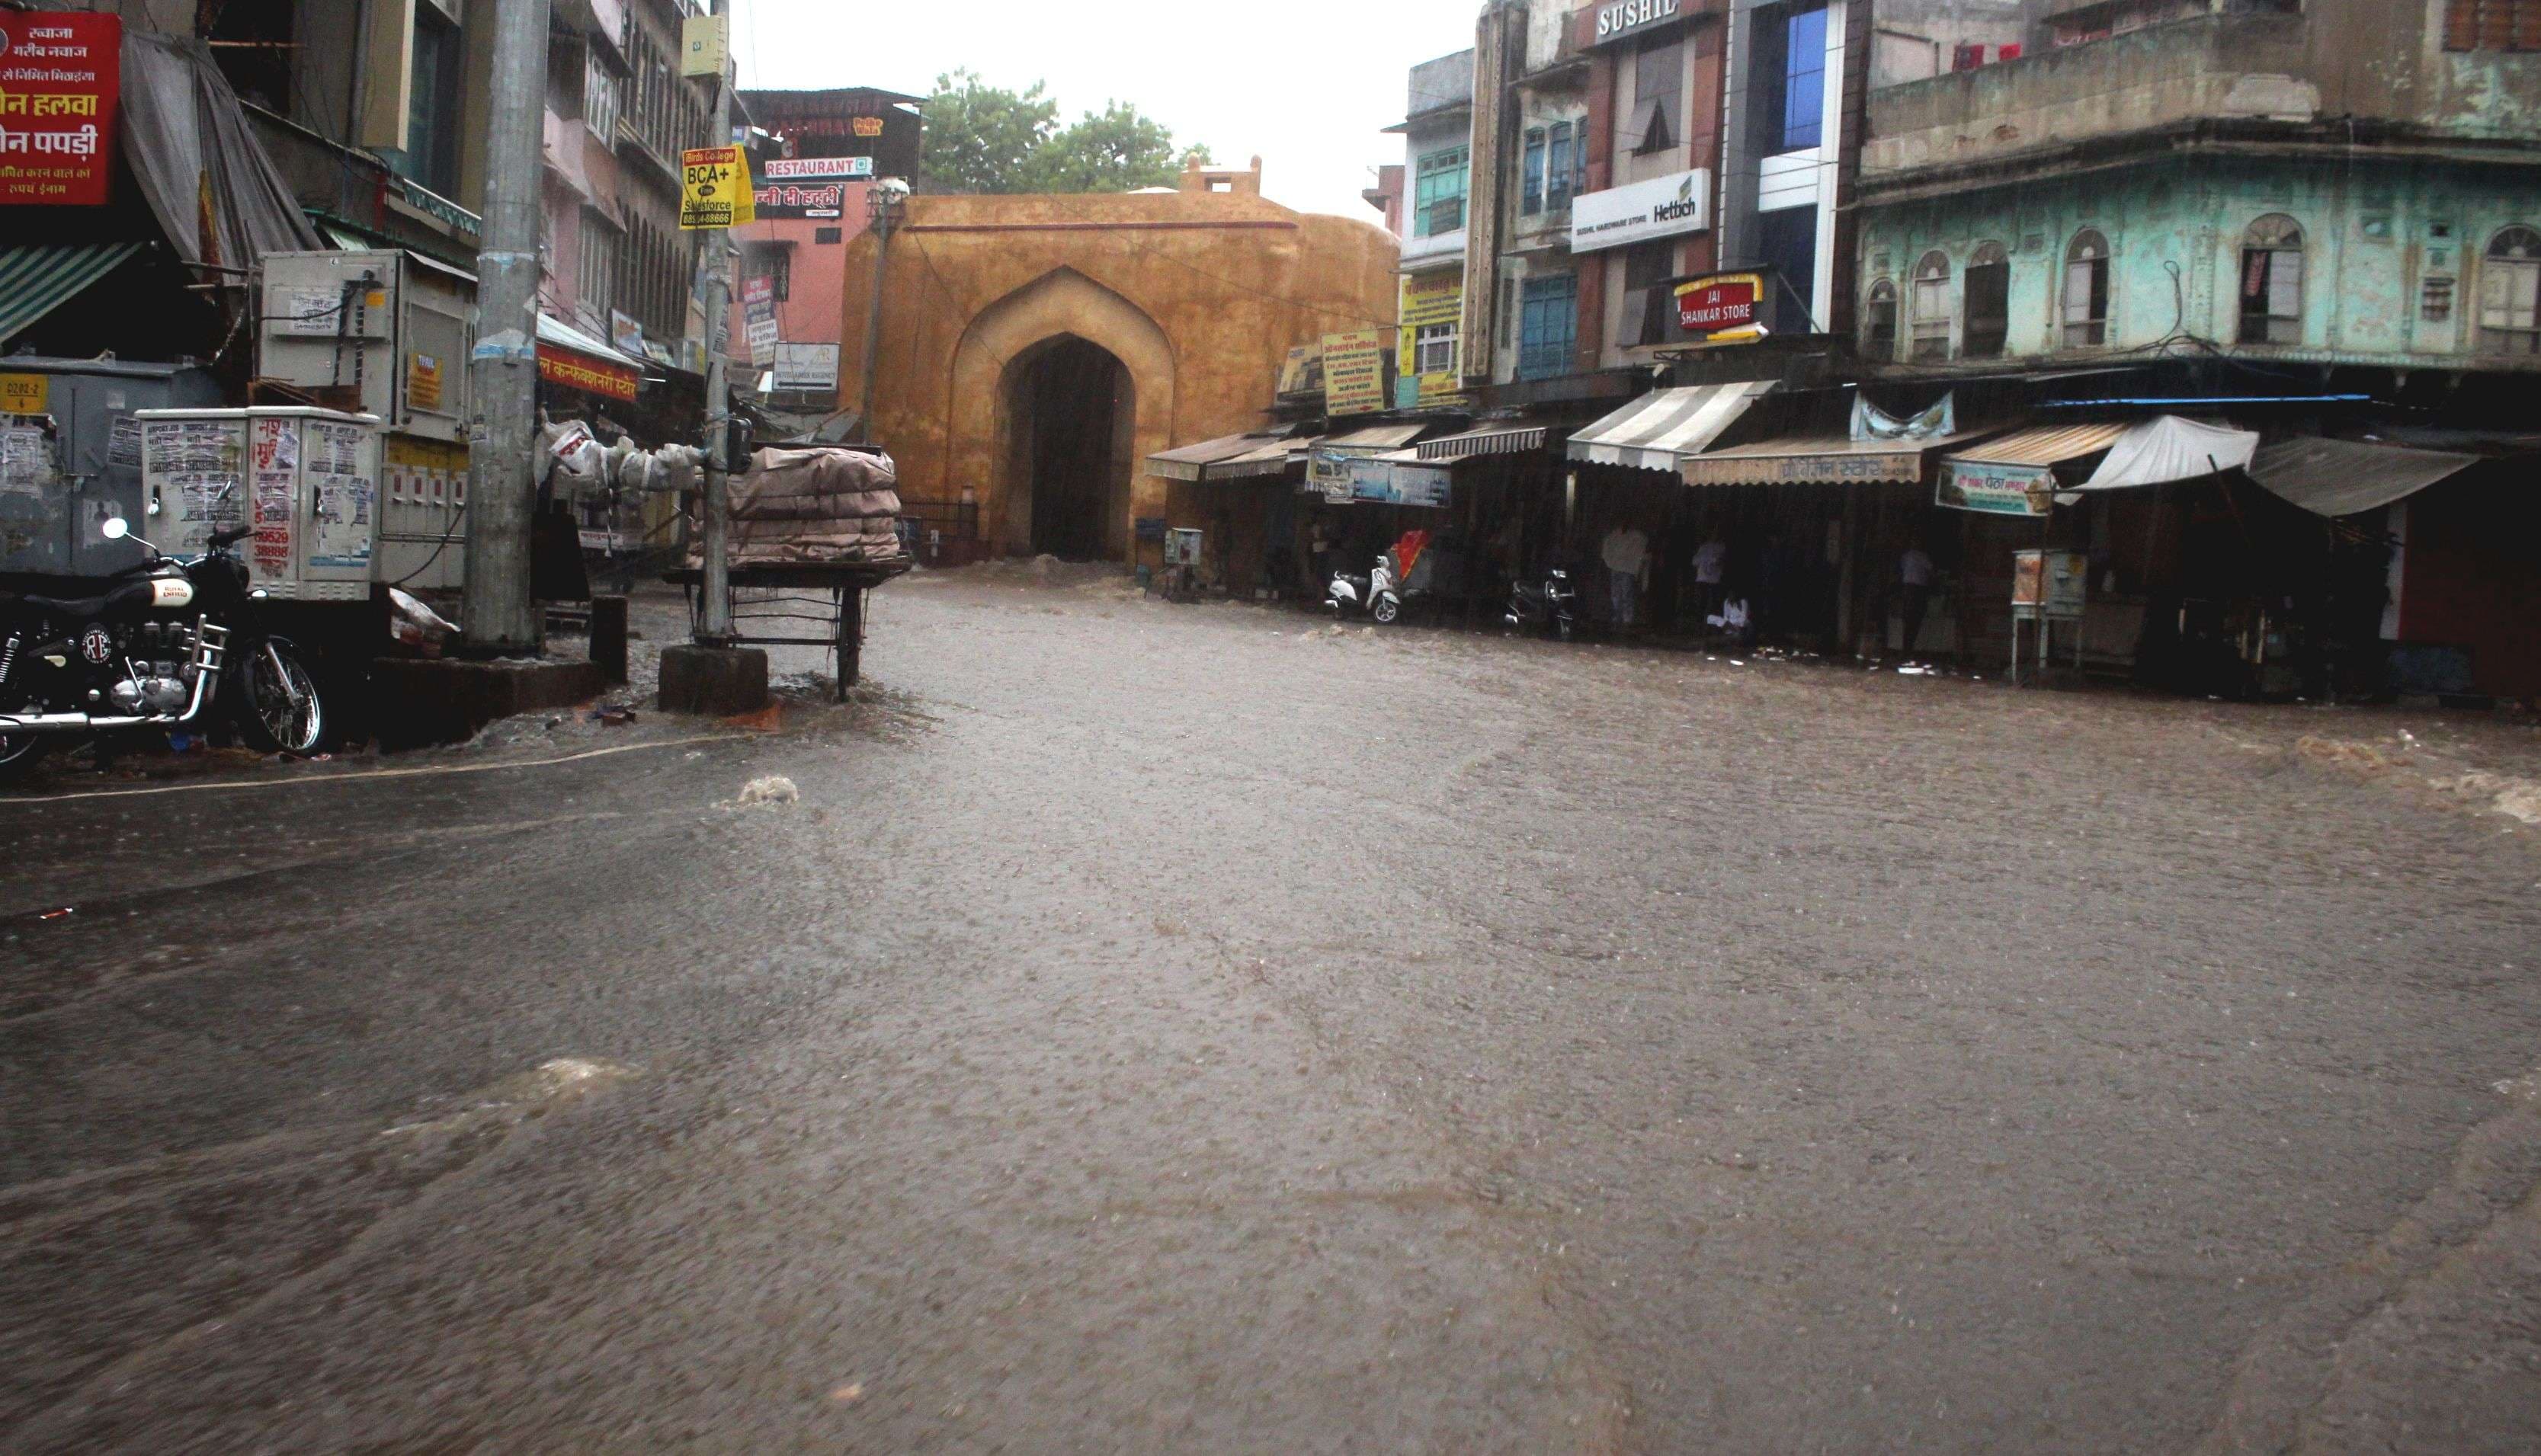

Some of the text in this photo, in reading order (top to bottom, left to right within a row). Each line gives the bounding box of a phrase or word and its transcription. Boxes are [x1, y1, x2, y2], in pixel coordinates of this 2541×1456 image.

[1599, 0, 1677, 35] SUSHIL
[34, 94, 98, 116] हलवा
[34, 124, 98, 162] पपड़ी
[688, 165, 729, 184] BCA+
[765, 159, 854, 176] RESTAURANT
[1596, 219, 1627, 231] HARDWARE
[1628, 214, 1647, 226] STORE
[1654, 197, 1695, 222] Hettich
[1707, 290, 1720, 304] JAI
[1681, 304, 1751, 325] SHANKAR STORE
